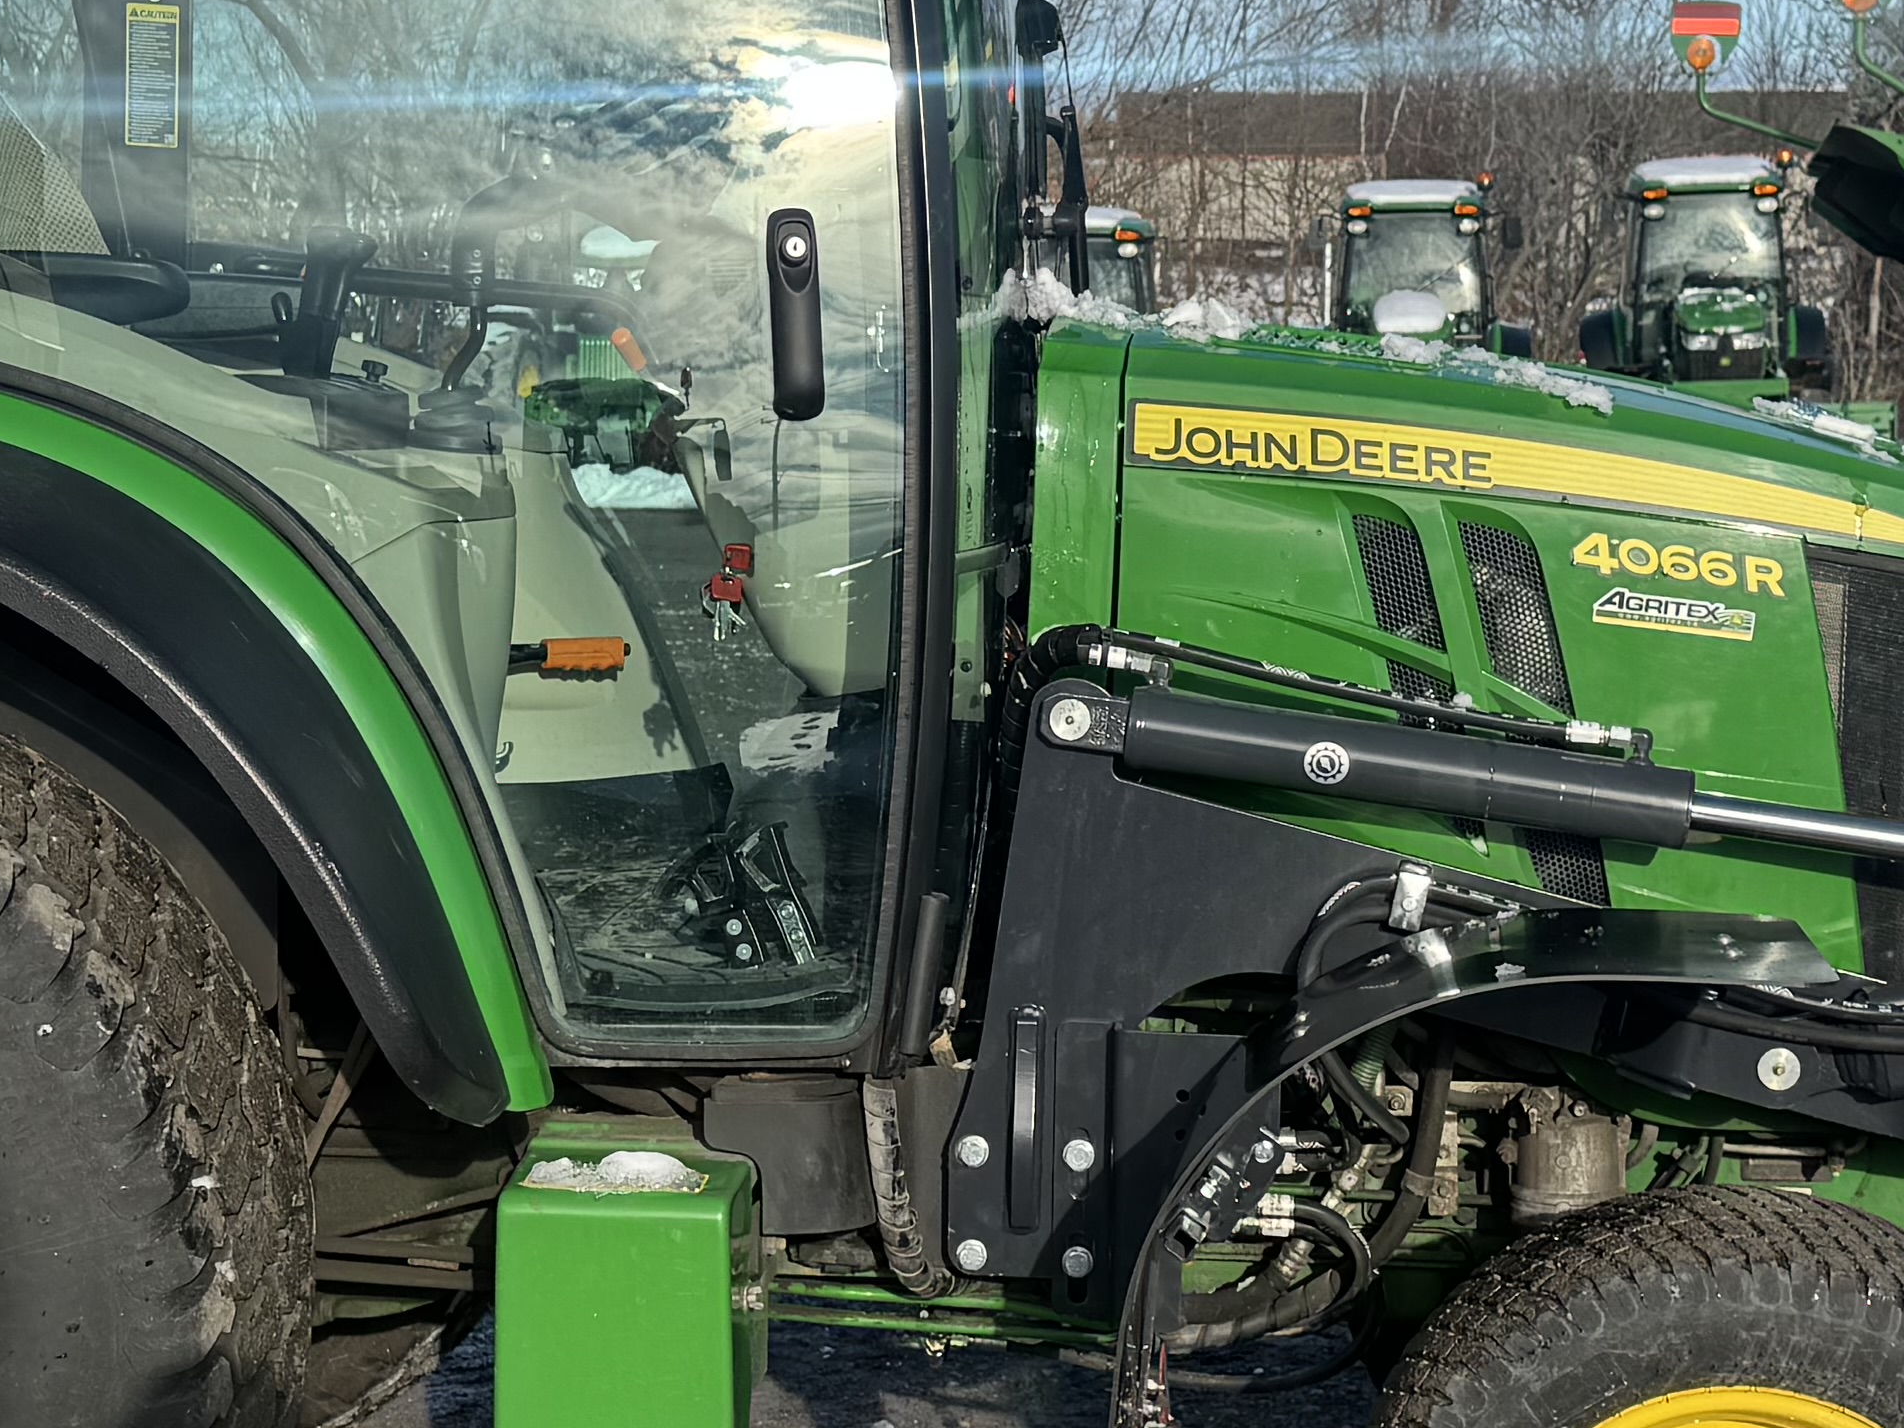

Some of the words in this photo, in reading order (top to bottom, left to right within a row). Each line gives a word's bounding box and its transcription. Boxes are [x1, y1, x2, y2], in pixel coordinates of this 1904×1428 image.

[1154, 417, 1298, 466] JOHN
[1309, 427, 1493, 483] DEERE
[1597, 590, 1722, 623] AGRITEX
